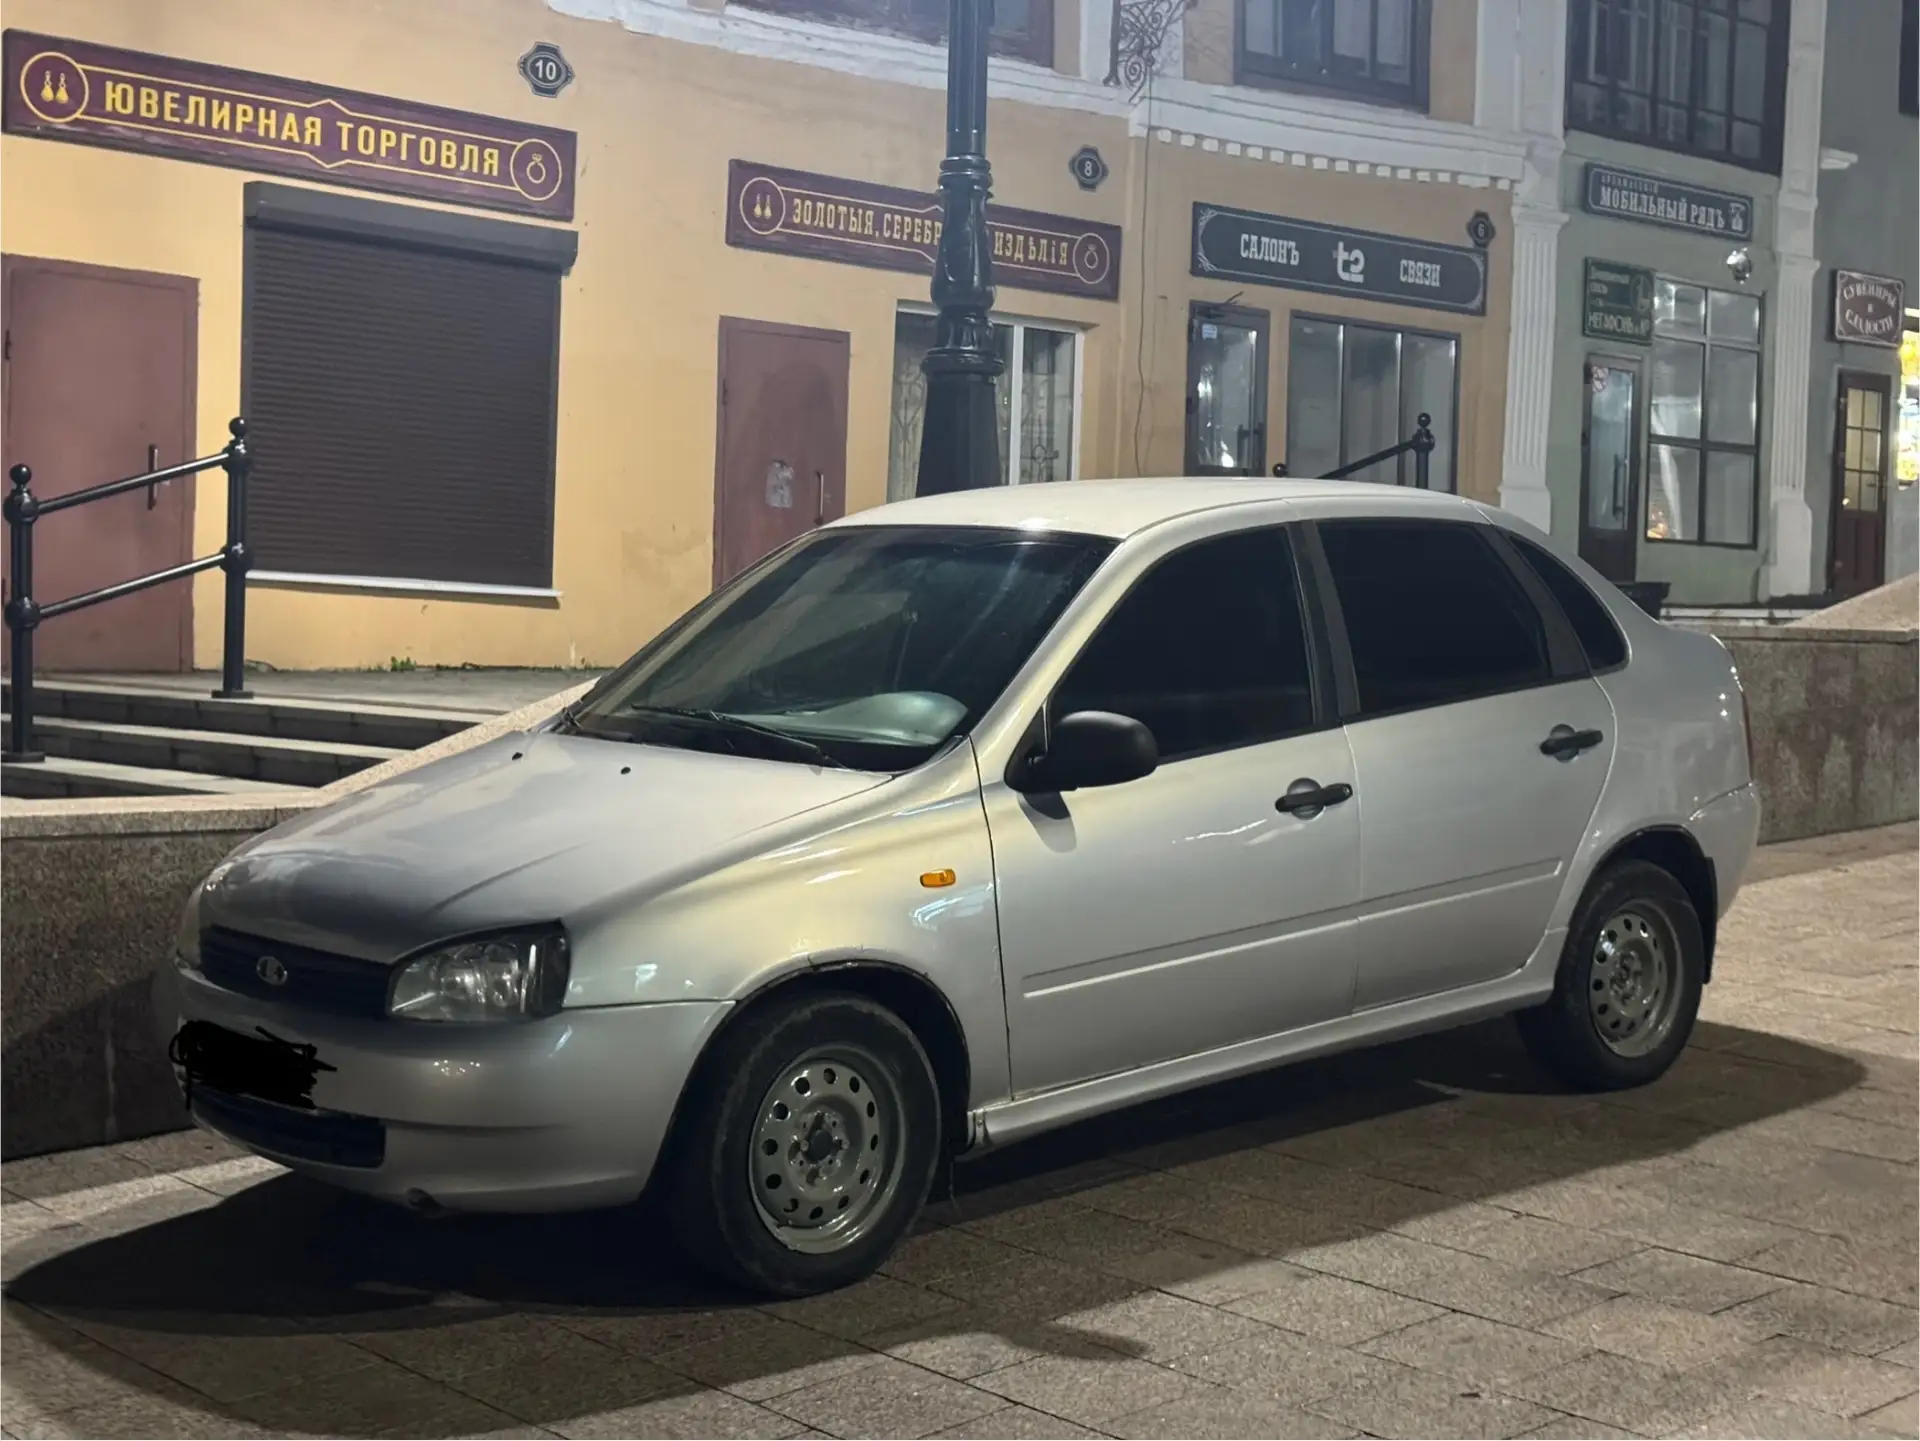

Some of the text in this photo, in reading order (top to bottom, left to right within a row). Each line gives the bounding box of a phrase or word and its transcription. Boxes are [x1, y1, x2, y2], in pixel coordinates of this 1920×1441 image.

[535, 59, 557, 81] 10
[104, 80, 500, 178] ЮВЕЛИРНАЯ ТОРГОВЛЯ
[1083, 160, 1093, 177] 8
[1599, 186, 1726, 230] МОБИЛЬНЫЙ РЯДЪ
[883, 212, 944, 246] СЕРЕБР
[1240, 232, 1301, 266] САЛОНЪ
[1399, 258, 1442, 288] СВЯЗИ
